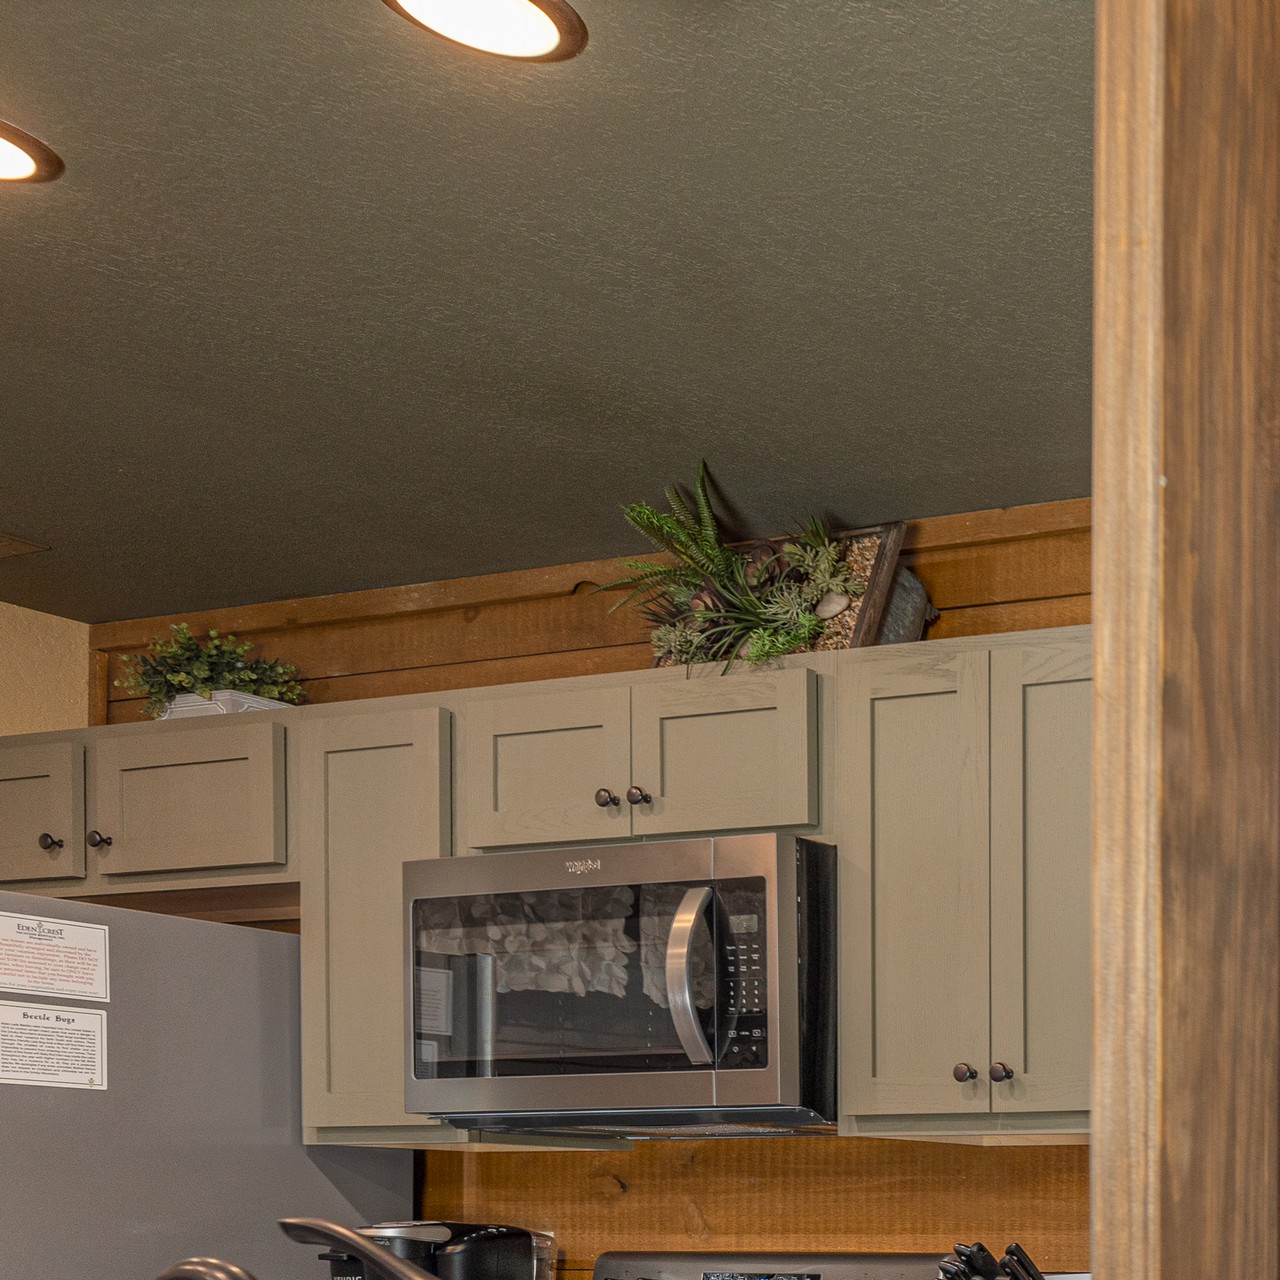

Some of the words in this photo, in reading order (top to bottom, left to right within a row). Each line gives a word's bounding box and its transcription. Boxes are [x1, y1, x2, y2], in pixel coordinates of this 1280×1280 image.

[17, 924, 37, 932] EDEN
[23, 1012, 50, 1021] Beetle
[55, 1015, 75, 1024] Bugs
